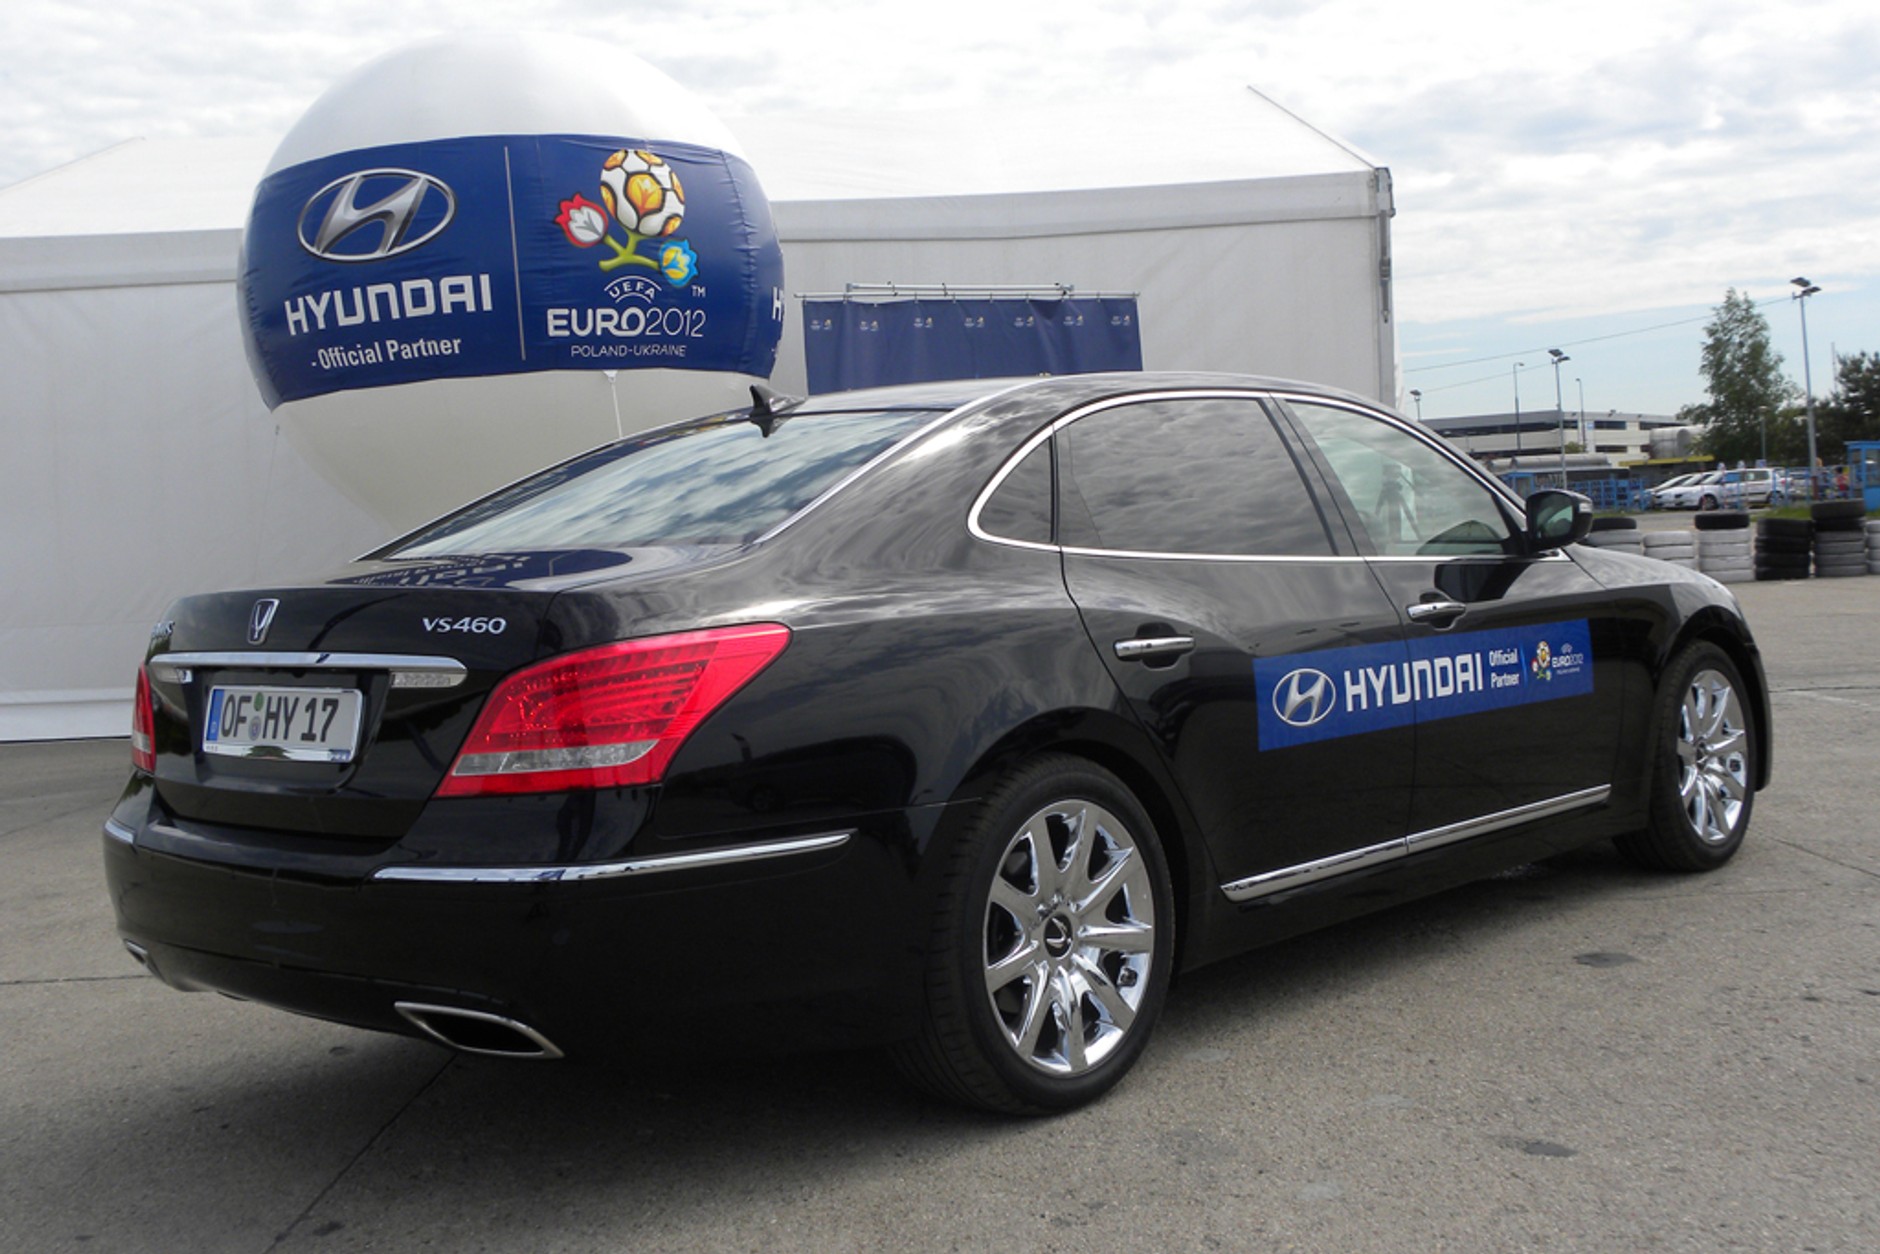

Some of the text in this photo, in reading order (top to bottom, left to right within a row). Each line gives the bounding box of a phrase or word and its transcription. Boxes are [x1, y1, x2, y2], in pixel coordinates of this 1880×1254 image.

[608, 281, 655, 299] UEFA
[692, 285, 706, 297] TM
[284, 274, 493, 336] HYUNDAI
[385, 337, 462, 361] Partner
[570, 344, 687, 357] POLAND-UKRAINE
[422, 617, 506, 634] VS460
[1489, 648, 1518, 667] Official
[1344, 652, 1483, 712] HYUNDAI
[1490, 672, 1519, 688] Partner
[221, 694, 339, 742] OF HY 17
